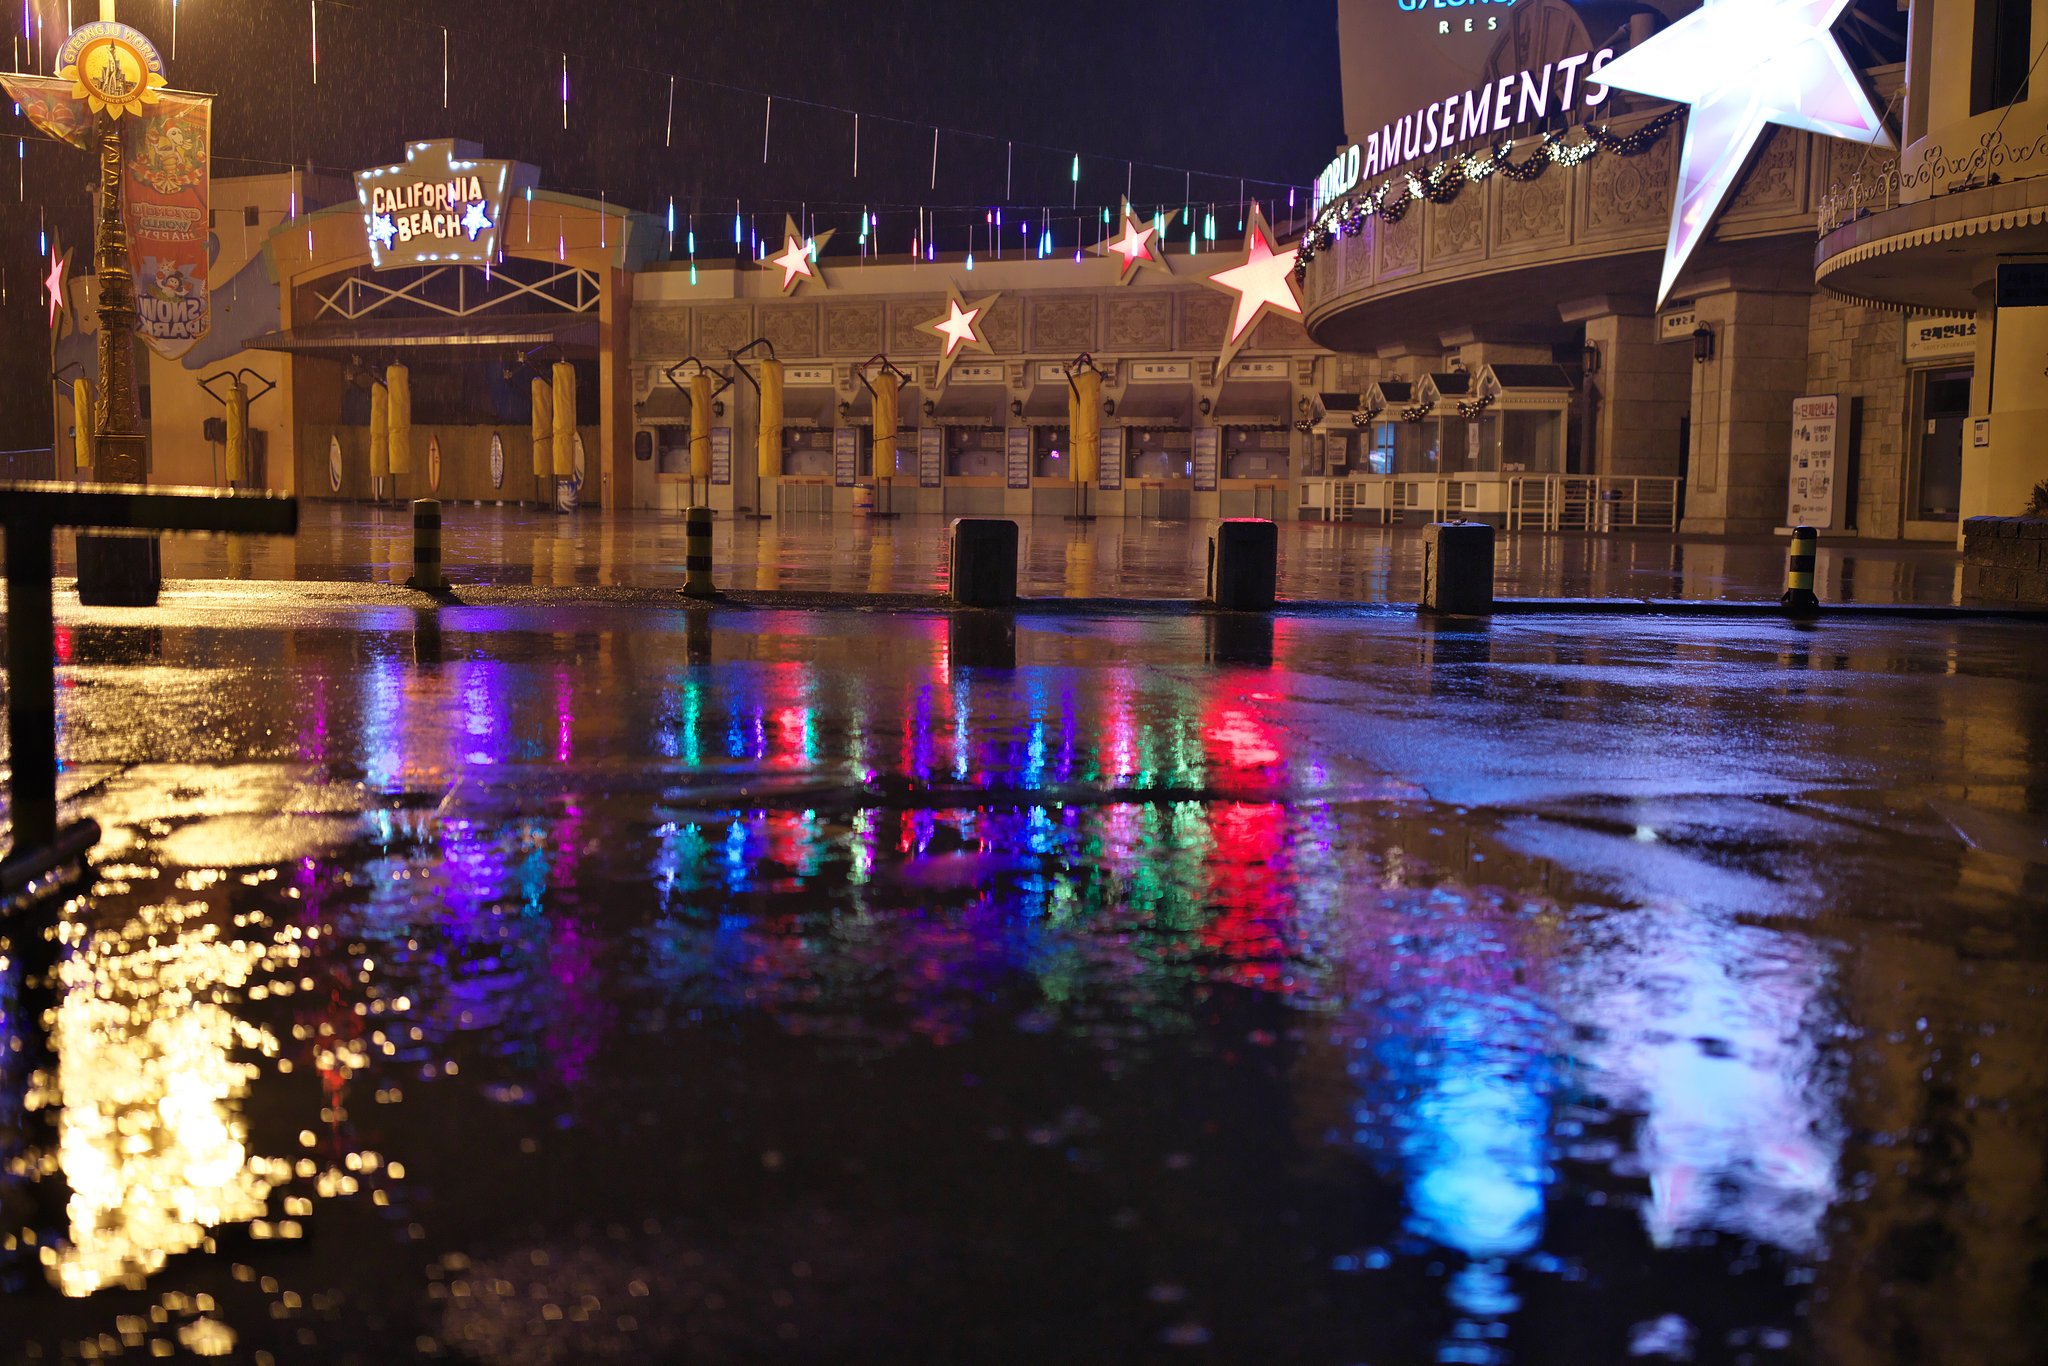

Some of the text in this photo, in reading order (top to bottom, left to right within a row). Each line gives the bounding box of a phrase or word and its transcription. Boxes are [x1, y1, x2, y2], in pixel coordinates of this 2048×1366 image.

[64, 23, 160, 71] GYEONGJU WORLD
[1363, 48, 1614, 181] AMUSEMENTS
[373, 176, 483, 214] CALIFORNIA
[397, 210, 462, 242] BEACH
[1920, 323, 1977, 341] 단체안내소
